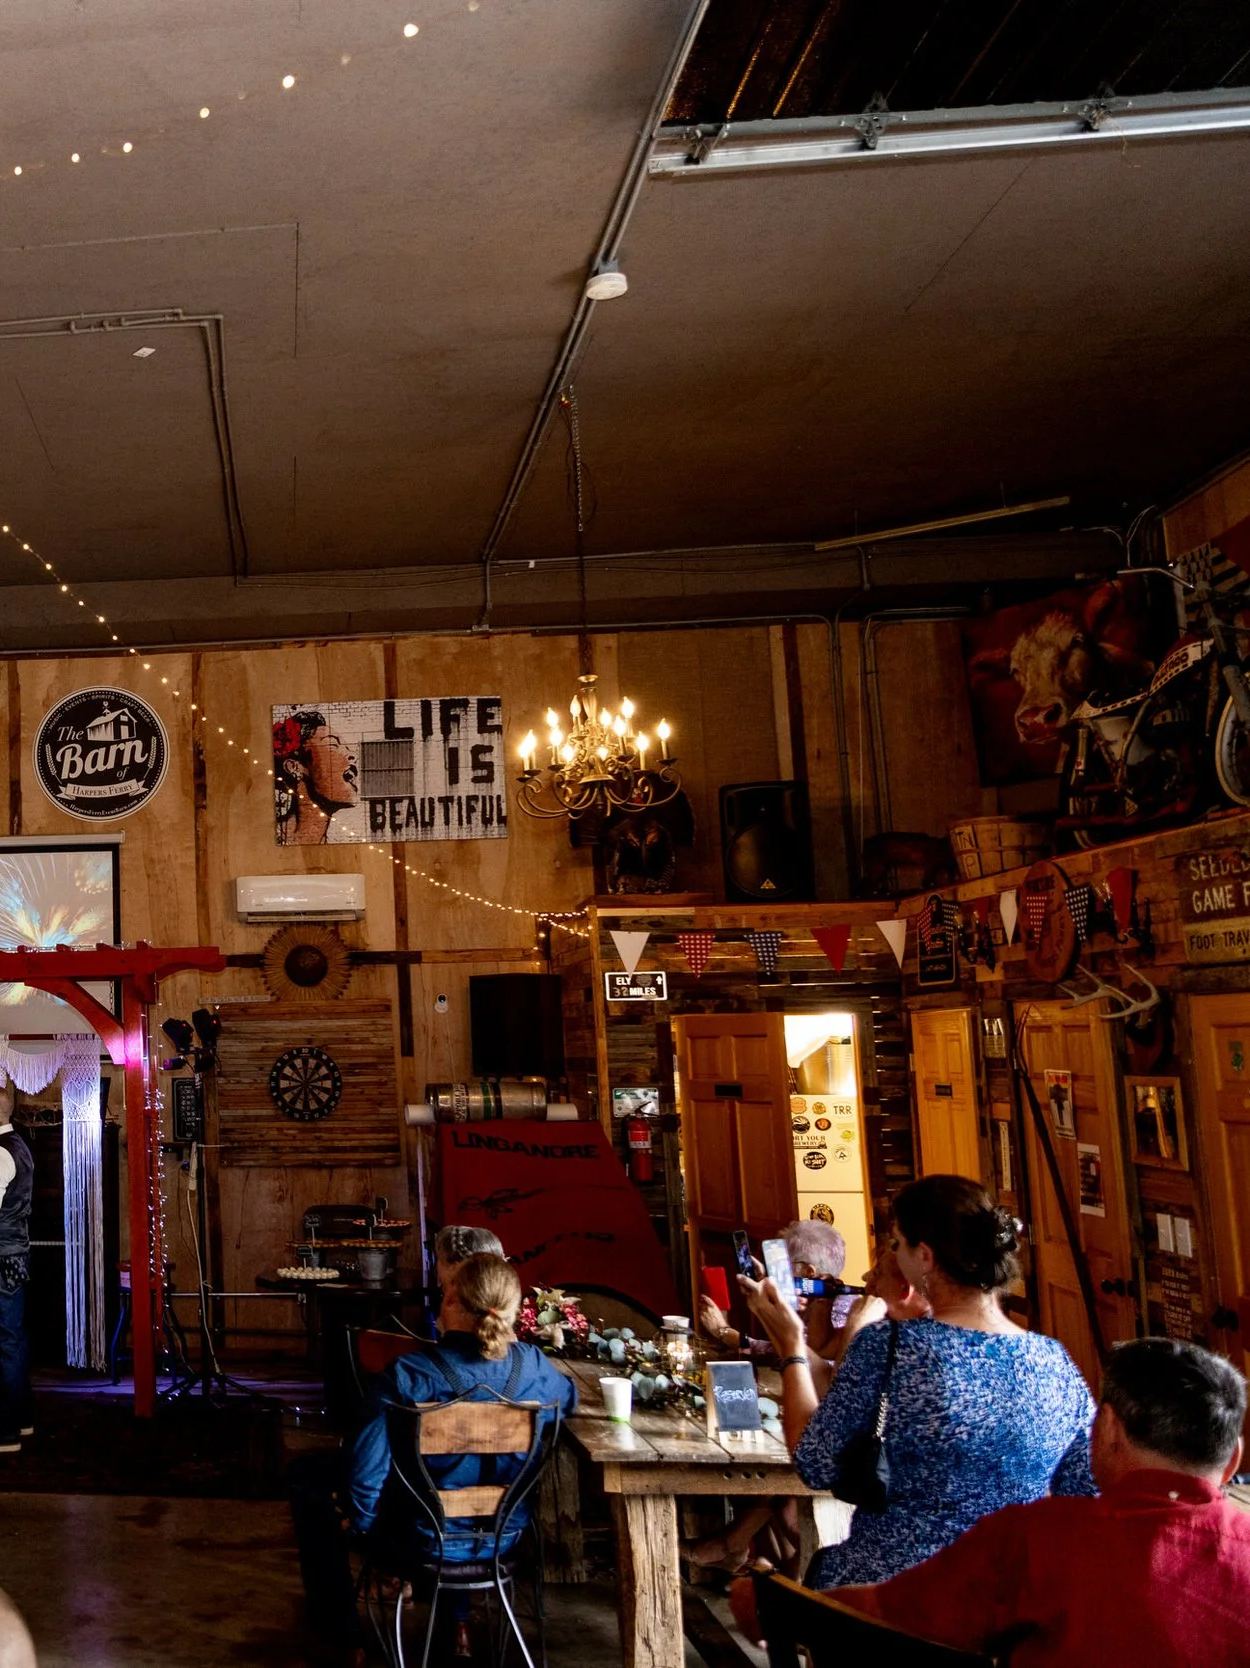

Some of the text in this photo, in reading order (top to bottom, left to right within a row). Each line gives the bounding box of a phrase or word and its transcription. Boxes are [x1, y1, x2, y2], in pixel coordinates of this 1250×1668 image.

[47, 713, 63, 735] MUSIC
[65, 697, 87, 712] EVENTS
[119, 697, 138, 710] CRAFT
[137, 709, 152, 723] BEER
[383, 698, 503, 740] LIFE
[57, 725, 85, 742] The
[55, 739, 149, 780] Barn
[116, 766, 131, 781] of
[448, 744, 494, 785] IS
[369, 794, 508, 832] BEAUTIFUL
[1192, 884, 1236, 914] GAME
[1190, 933, 1215, 951] FOOT
[615, 976, 631, 986] ELY
[629, 987, 657, 996] MILES
[833, 1105, 852, 1115] TRR
[451, 1130, 600, 1159] LINGANORE
